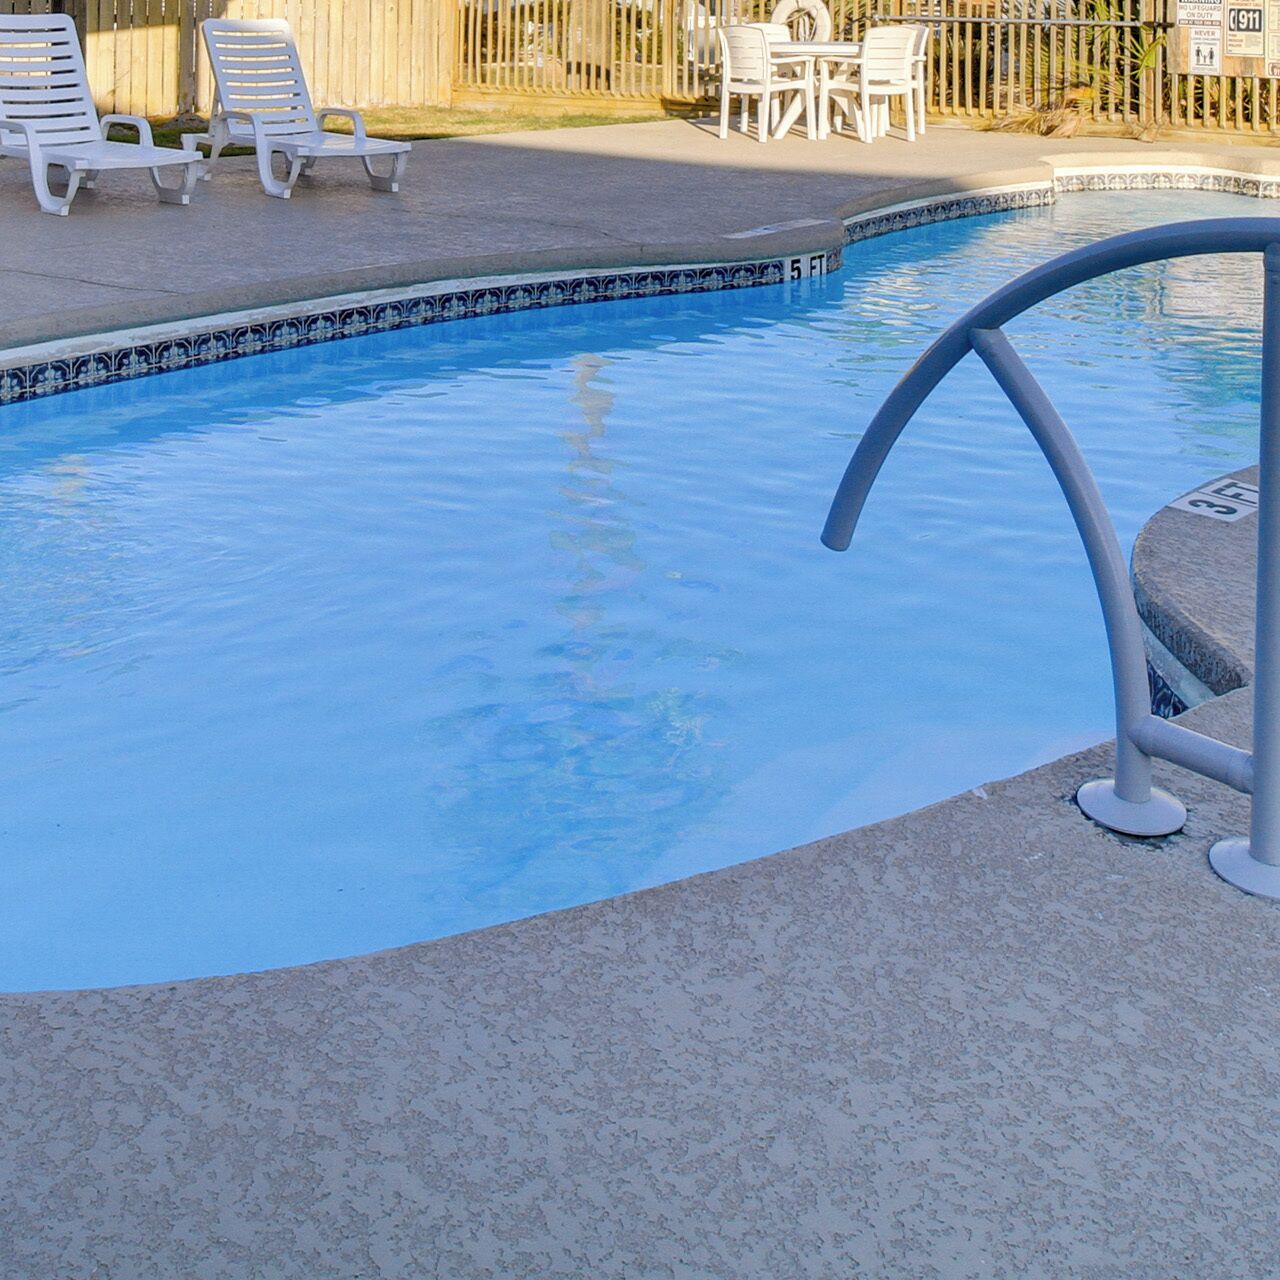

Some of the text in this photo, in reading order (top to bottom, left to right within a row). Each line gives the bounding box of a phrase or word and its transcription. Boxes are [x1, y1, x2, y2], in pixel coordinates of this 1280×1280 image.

[1238, 10, 1260, 29] 911
[790, 254, 825, 280] 5 FT
[1188, 482, 1258, 515] 3 FT
